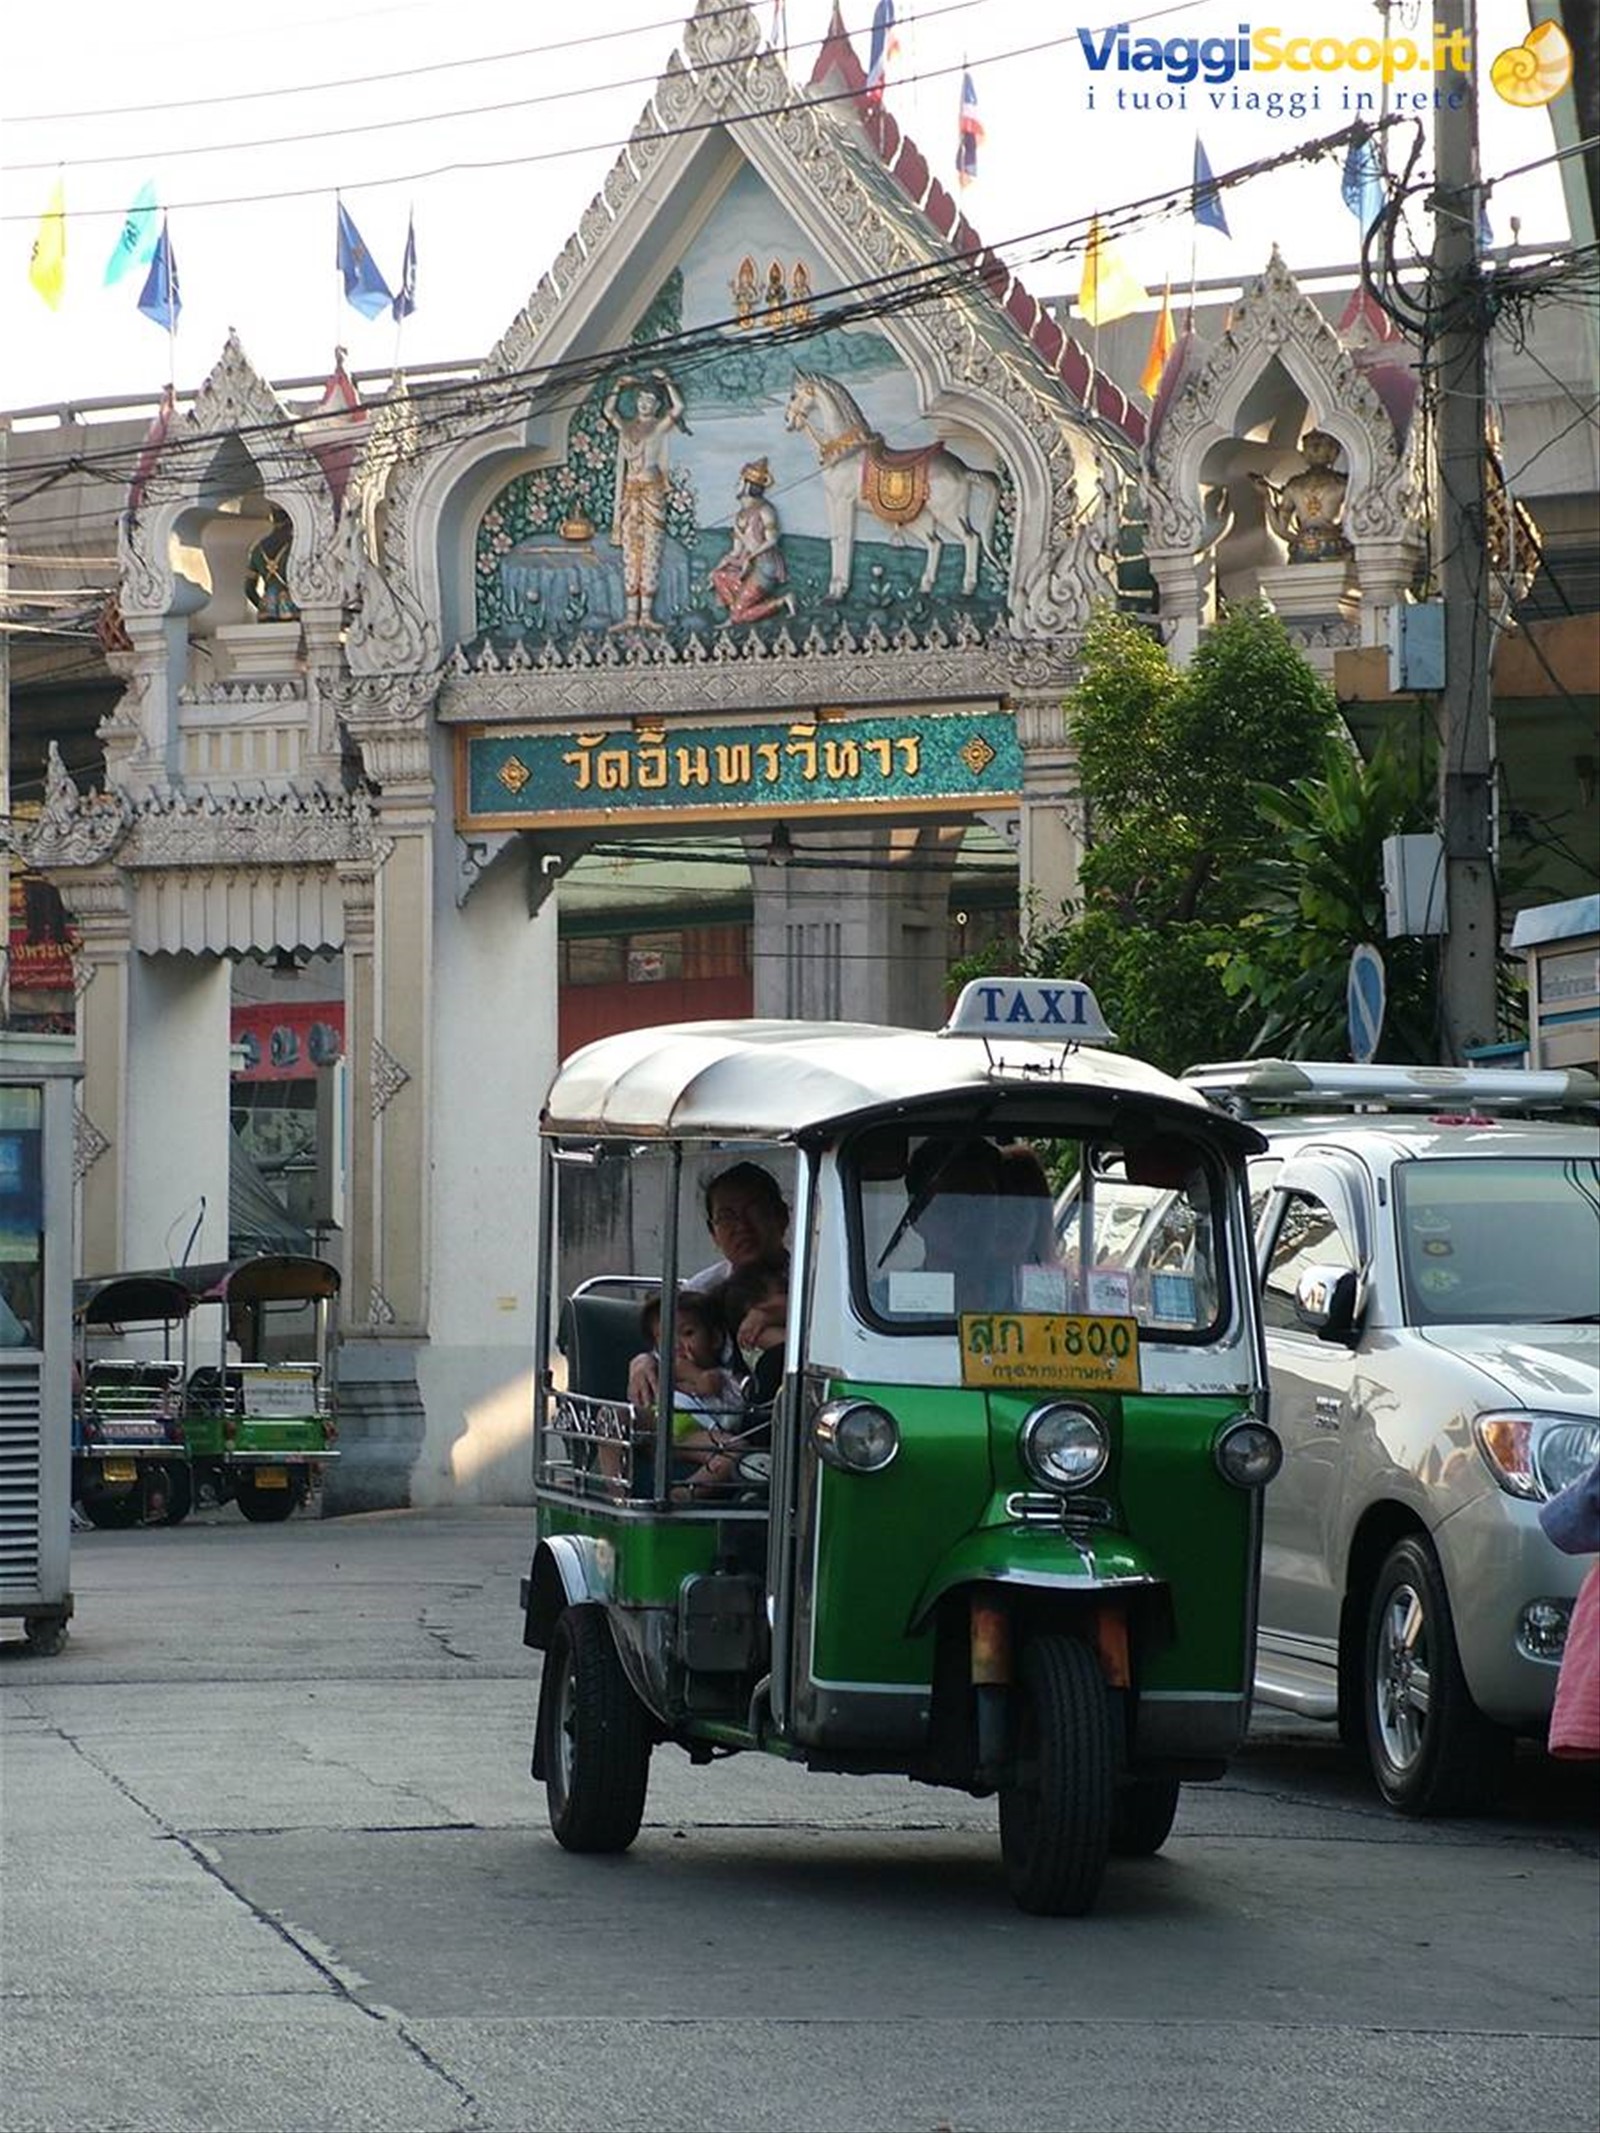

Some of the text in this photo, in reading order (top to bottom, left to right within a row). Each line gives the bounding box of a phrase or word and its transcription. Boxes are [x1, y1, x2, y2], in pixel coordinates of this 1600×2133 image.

[562, 724, 922, 791] วัดอินทรวิหาร
[977, 987, 1088, 1025] TAXI
